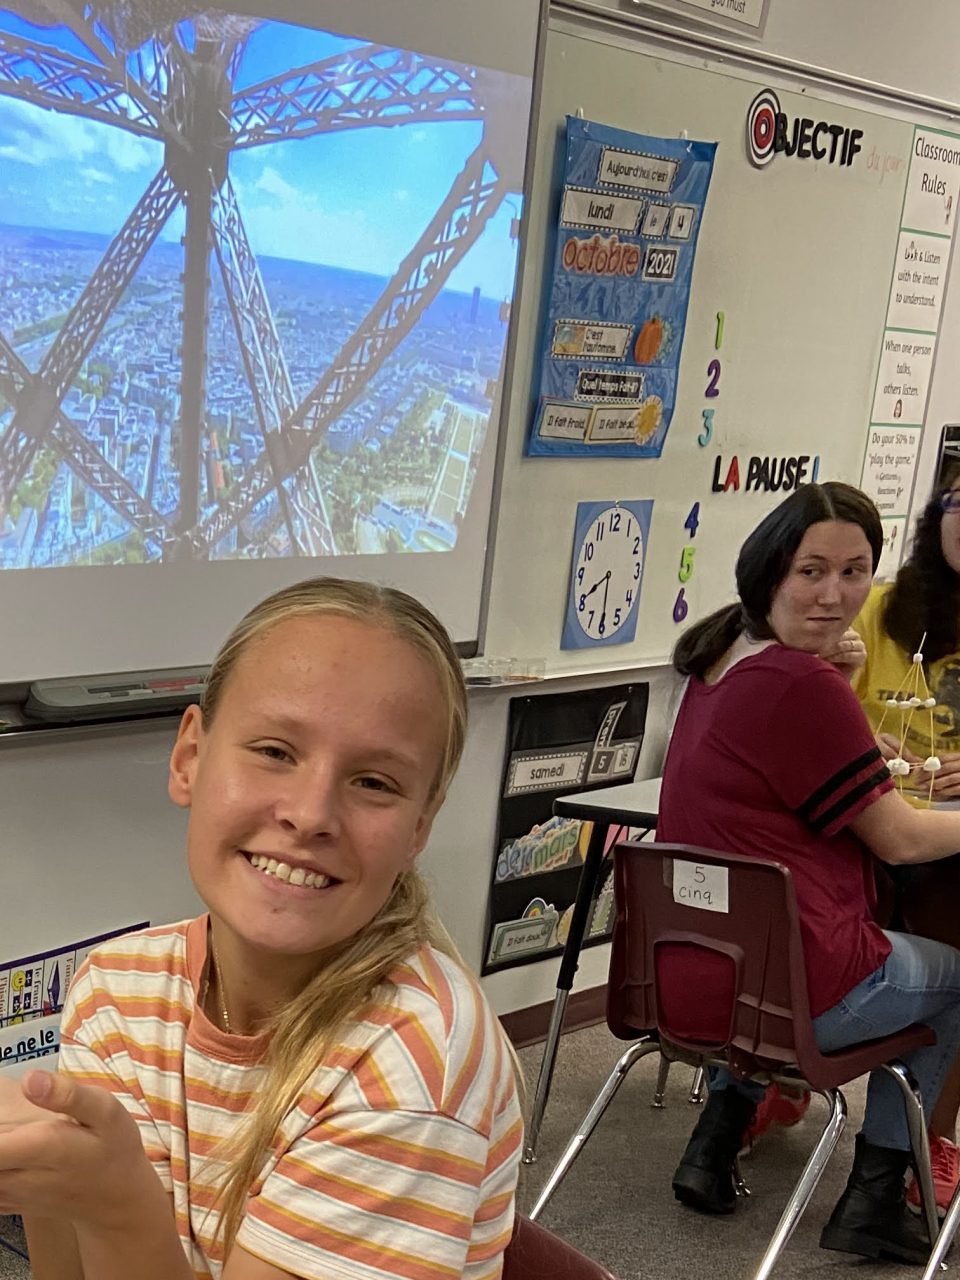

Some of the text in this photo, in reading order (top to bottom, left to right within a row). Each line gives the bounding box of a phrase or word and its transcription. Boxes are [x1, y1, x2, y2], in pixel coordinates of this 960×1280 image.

[921, 173, 946, 195] Rules
[588, 201, 614, 220] lundi
[677, 215, 685, 230] 4
[564, 237, 673, 275] octobre 2021
[897, 270, 911, 281] with
[912, 272, 921, 283] the
[896, 293, 902, 303] to
[715, 311, 725, 350] 1
[705, 359, 721, 398] 2
[883, 383, 901, 395] others
[698, 409, 715, 448] 3
[712, 455, 740, 493] LA
[609, 513, 621, 533] 12
[627, 519, 631, 538] 1
[685, 502, 700, 538] 4
[596, 523, 604, 541] 11
[584, 542, 594, 561] 10
[632, 536, 640, 555] 2
[634, 562, 641, 580] 3
[679, 547, 696, 583] 5
[577, 567, 585, 586] 9
[578, 594, 586, 612] 8
[625, 590, 632, 607] 4
[673, 588, 688, 623] 6
[587, 611, 594, 629] 7
[613, 608, 621, 626] 5
[530, 763, 564, 779] samedi
[598, 755, 607, 770] 5
[693, 866, 705, 883] 5
[679, 887, 712, 904] cinq
[17, 1037, 36, 1054] ne
[40, 1029, 54, 1046] le
